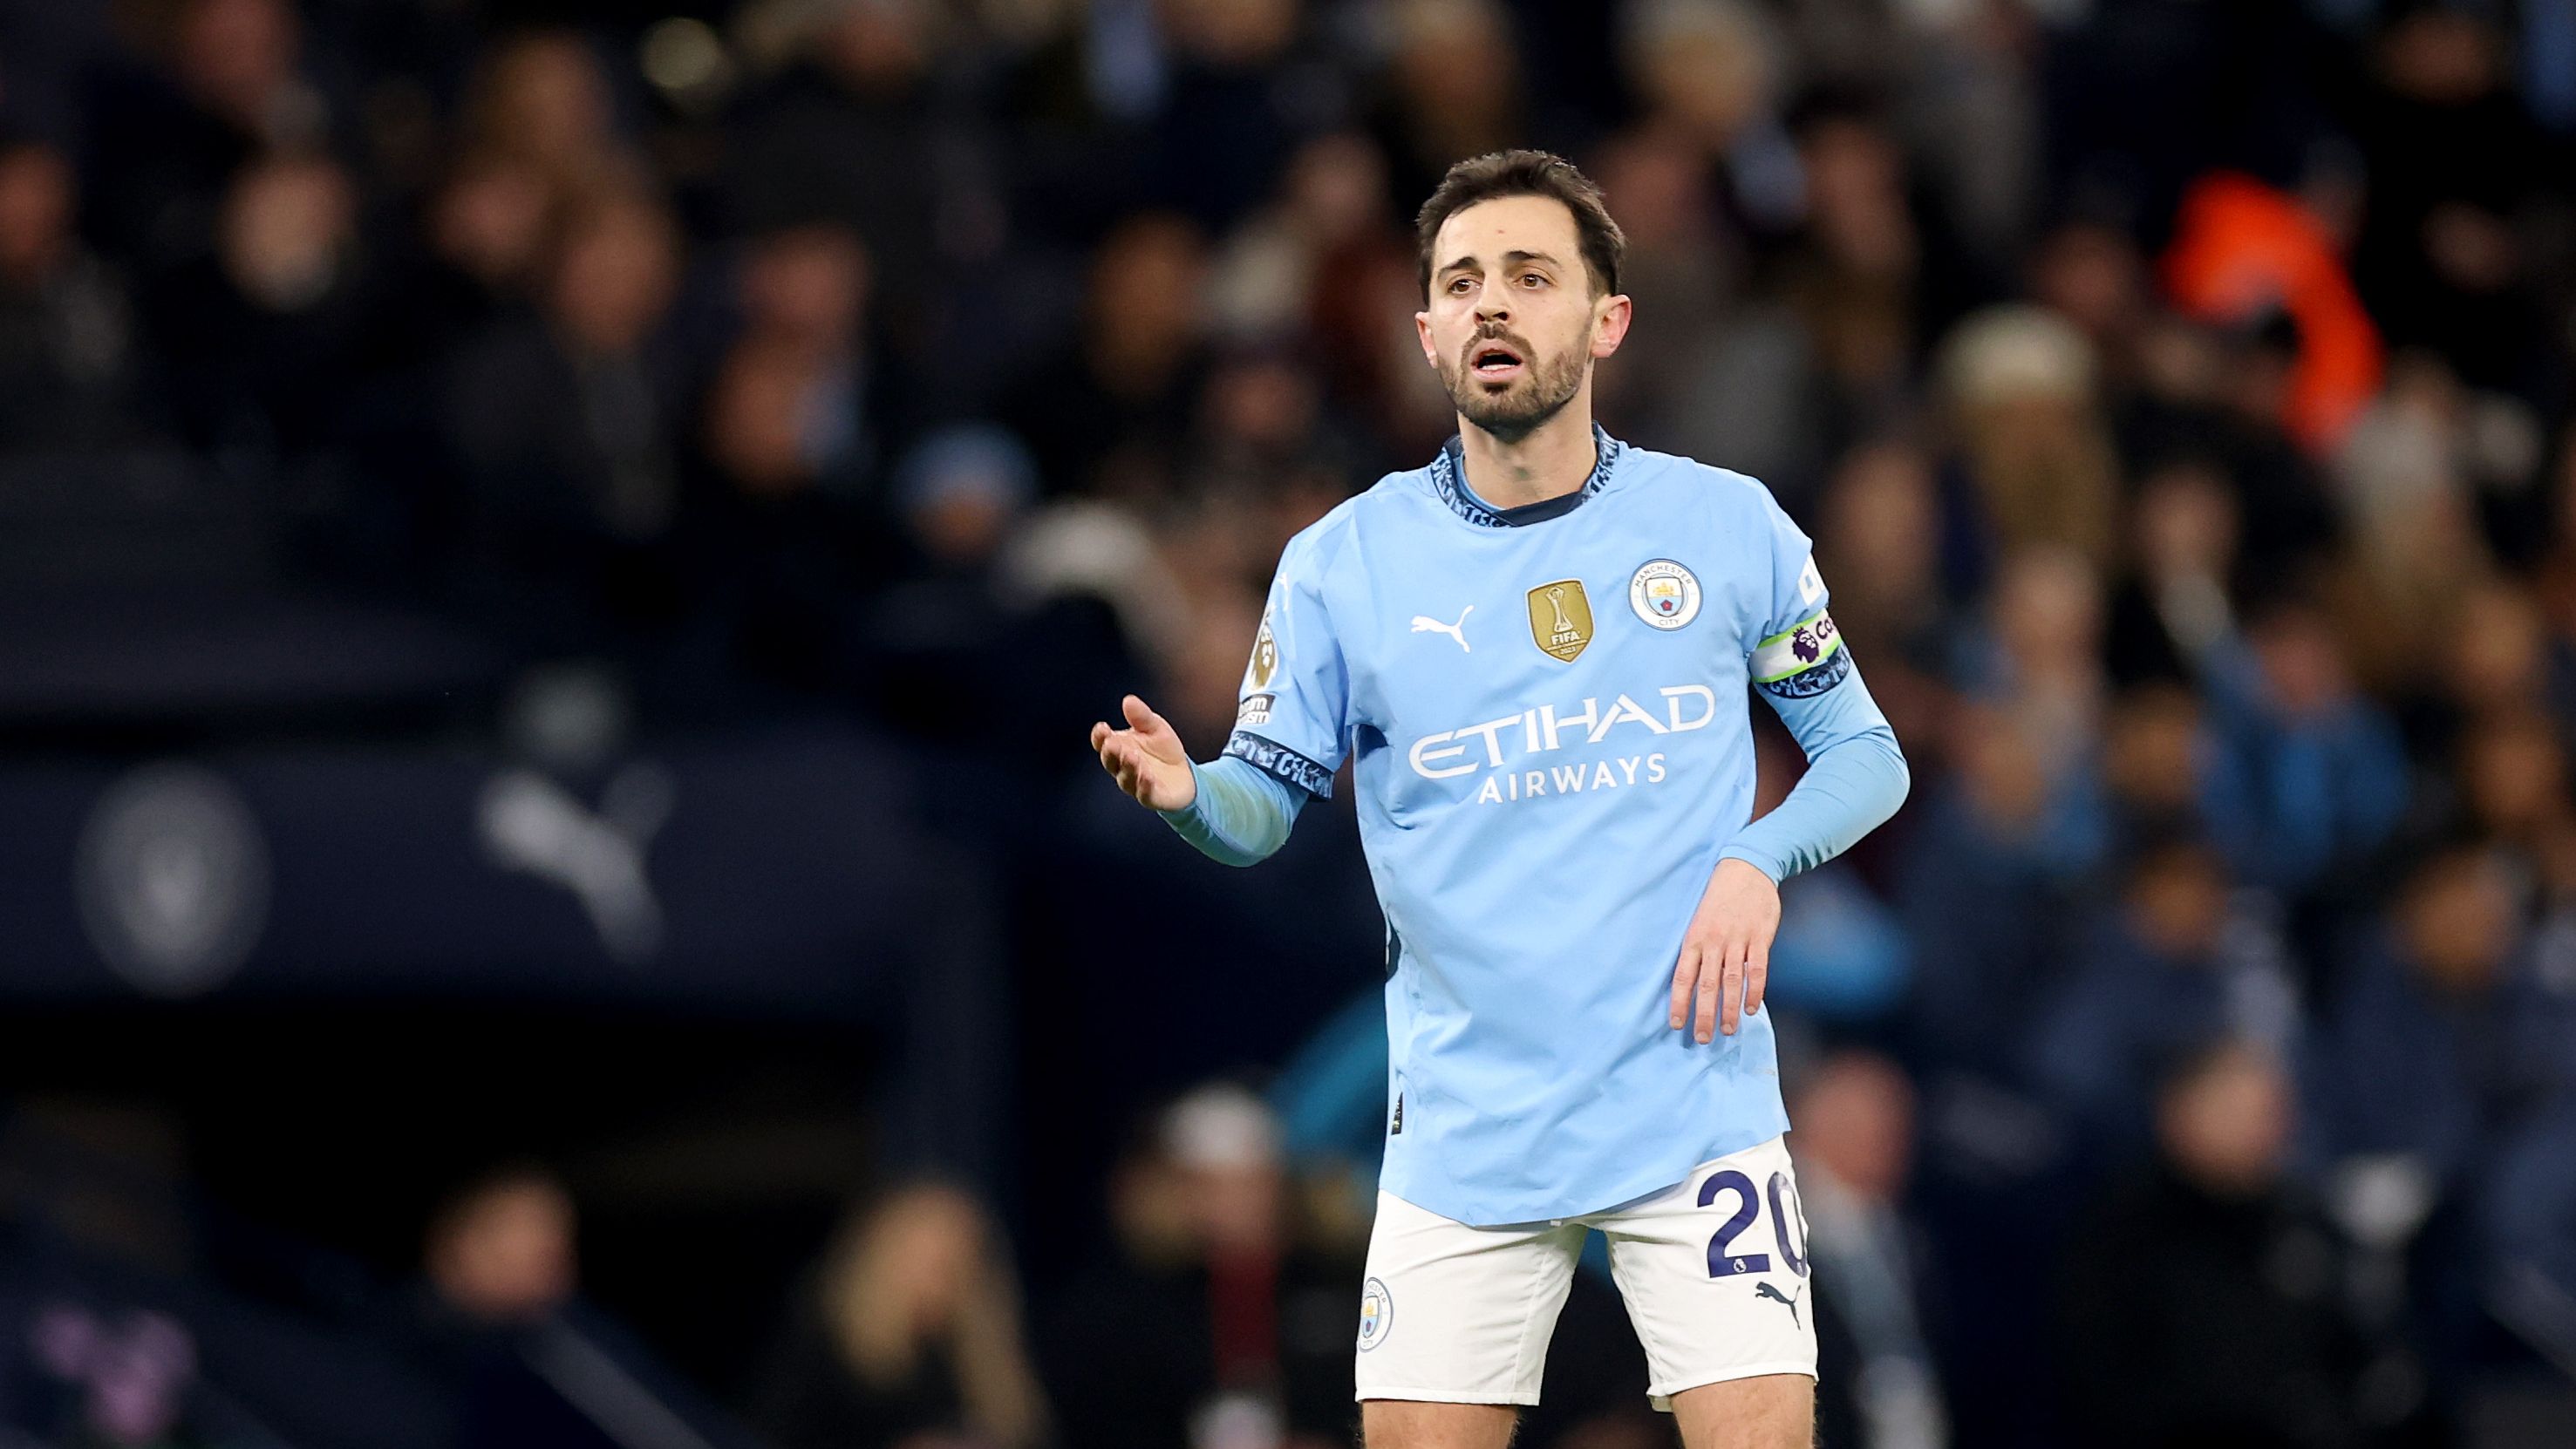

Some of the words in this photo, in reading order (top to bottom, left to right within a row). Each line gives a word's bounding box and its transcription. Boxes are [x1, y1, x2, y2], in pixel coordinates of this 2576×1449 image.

[1635, 565, 1693, 588] MANCHESTER
[1550, 630, 1580, 645] FIFA
[1408, 684, 1716, 779] ETIHAD
[1477, 753, 1666, 805] AIRWAYS
[1697, 1170, 1808, 1279] 20
